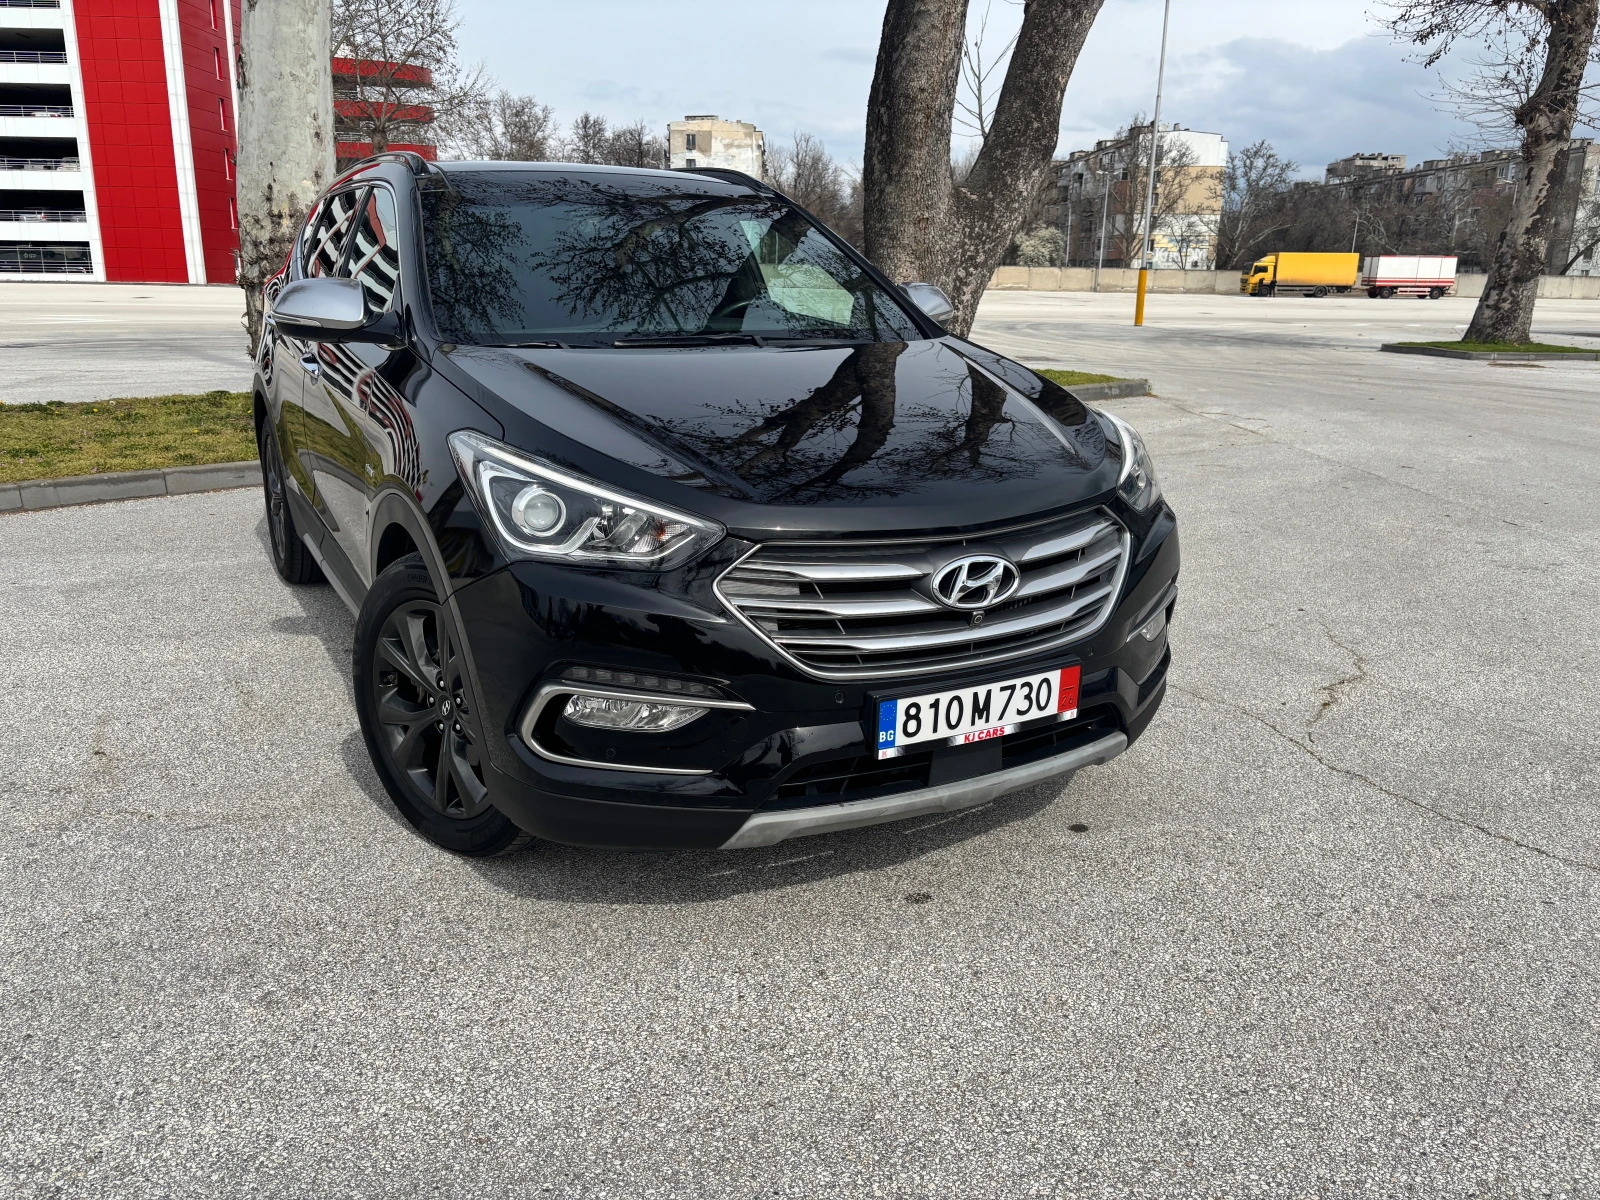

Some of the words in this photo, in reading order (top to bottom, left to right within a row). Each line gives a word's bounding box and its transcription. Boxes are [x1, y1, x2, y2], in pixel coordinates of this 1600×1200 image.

[1062, 694, 1074, 707] 26
[879, 730, 894, 743] BG
[964, 732, 976, 743] KJ
[978, 726, 1005, 741] CARS
